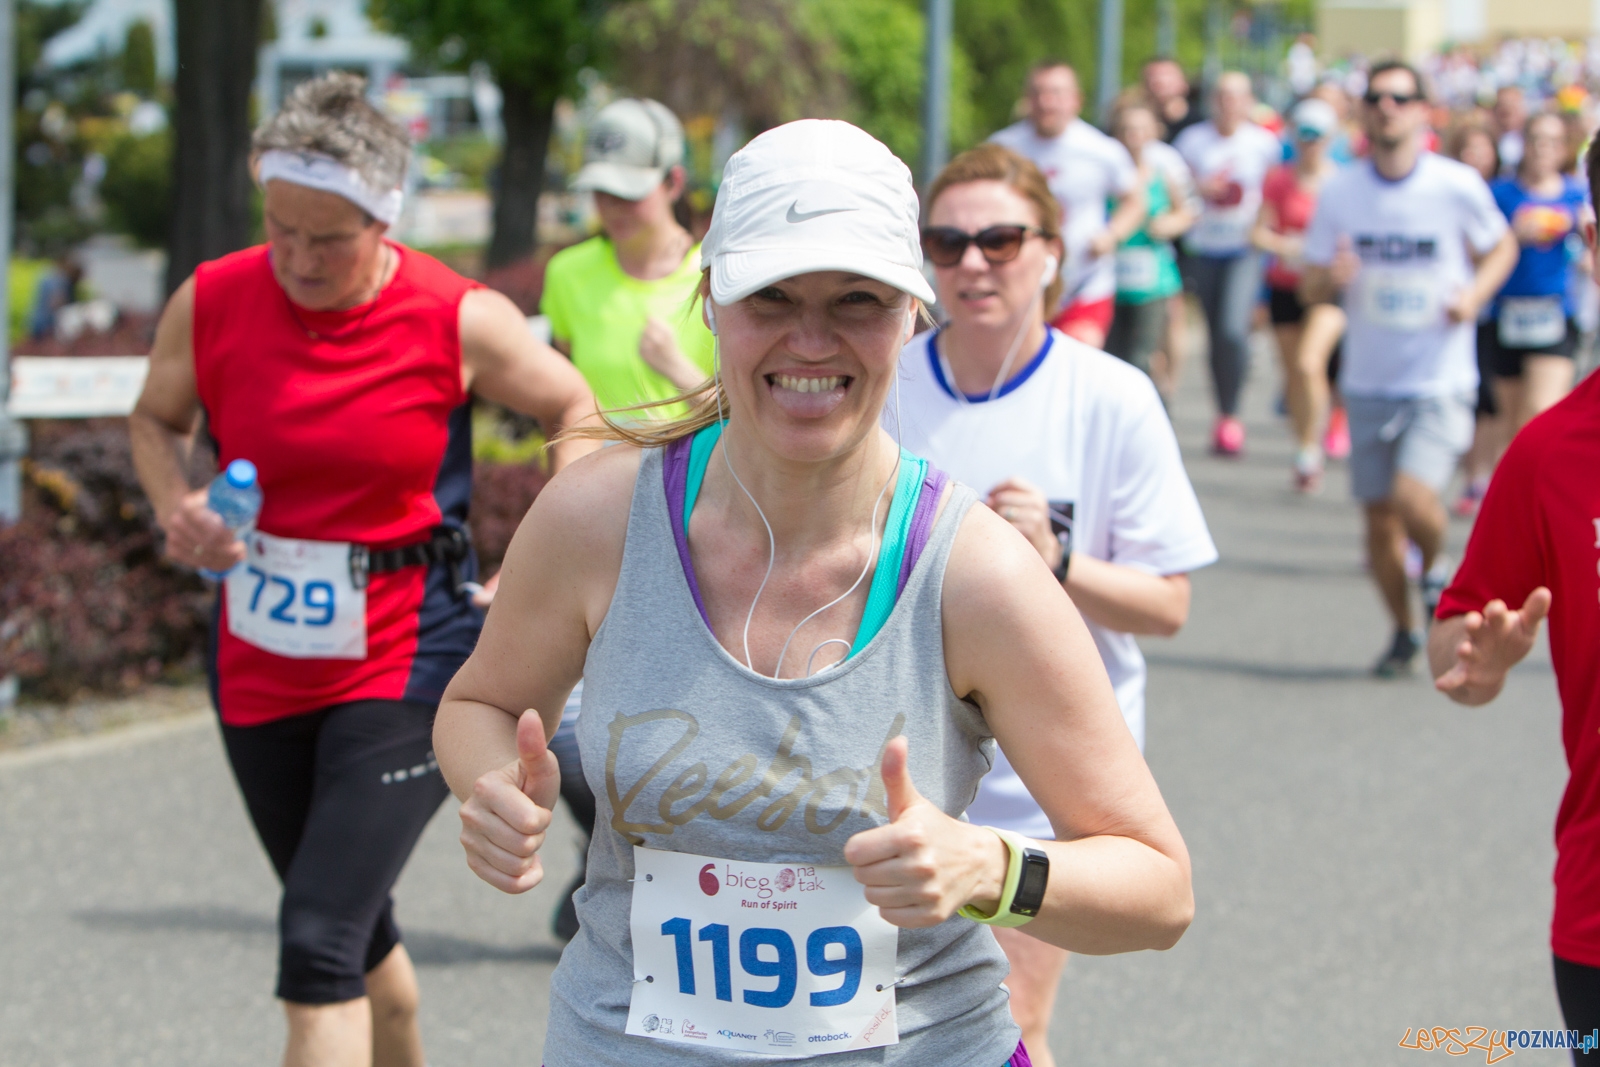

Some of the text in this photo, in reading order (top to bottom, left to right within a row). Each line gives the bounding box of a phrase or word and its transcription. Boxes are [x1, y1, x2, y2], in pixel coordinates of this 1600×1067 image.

[247, 565, 335, 626] 729
[796, 866, 815, 878] na
[698, 863, 773, 899] 6 bieg
[797, 876, 826, 892] tak
[741, 899, 798, 912] Run of Spirit
[661, 917, 863, 1008] 1199
[661, 1017, 673, 1025] na
[659, 1024, 675, 1035] tak
[808, 1031, 852, 1043] ottobock.
